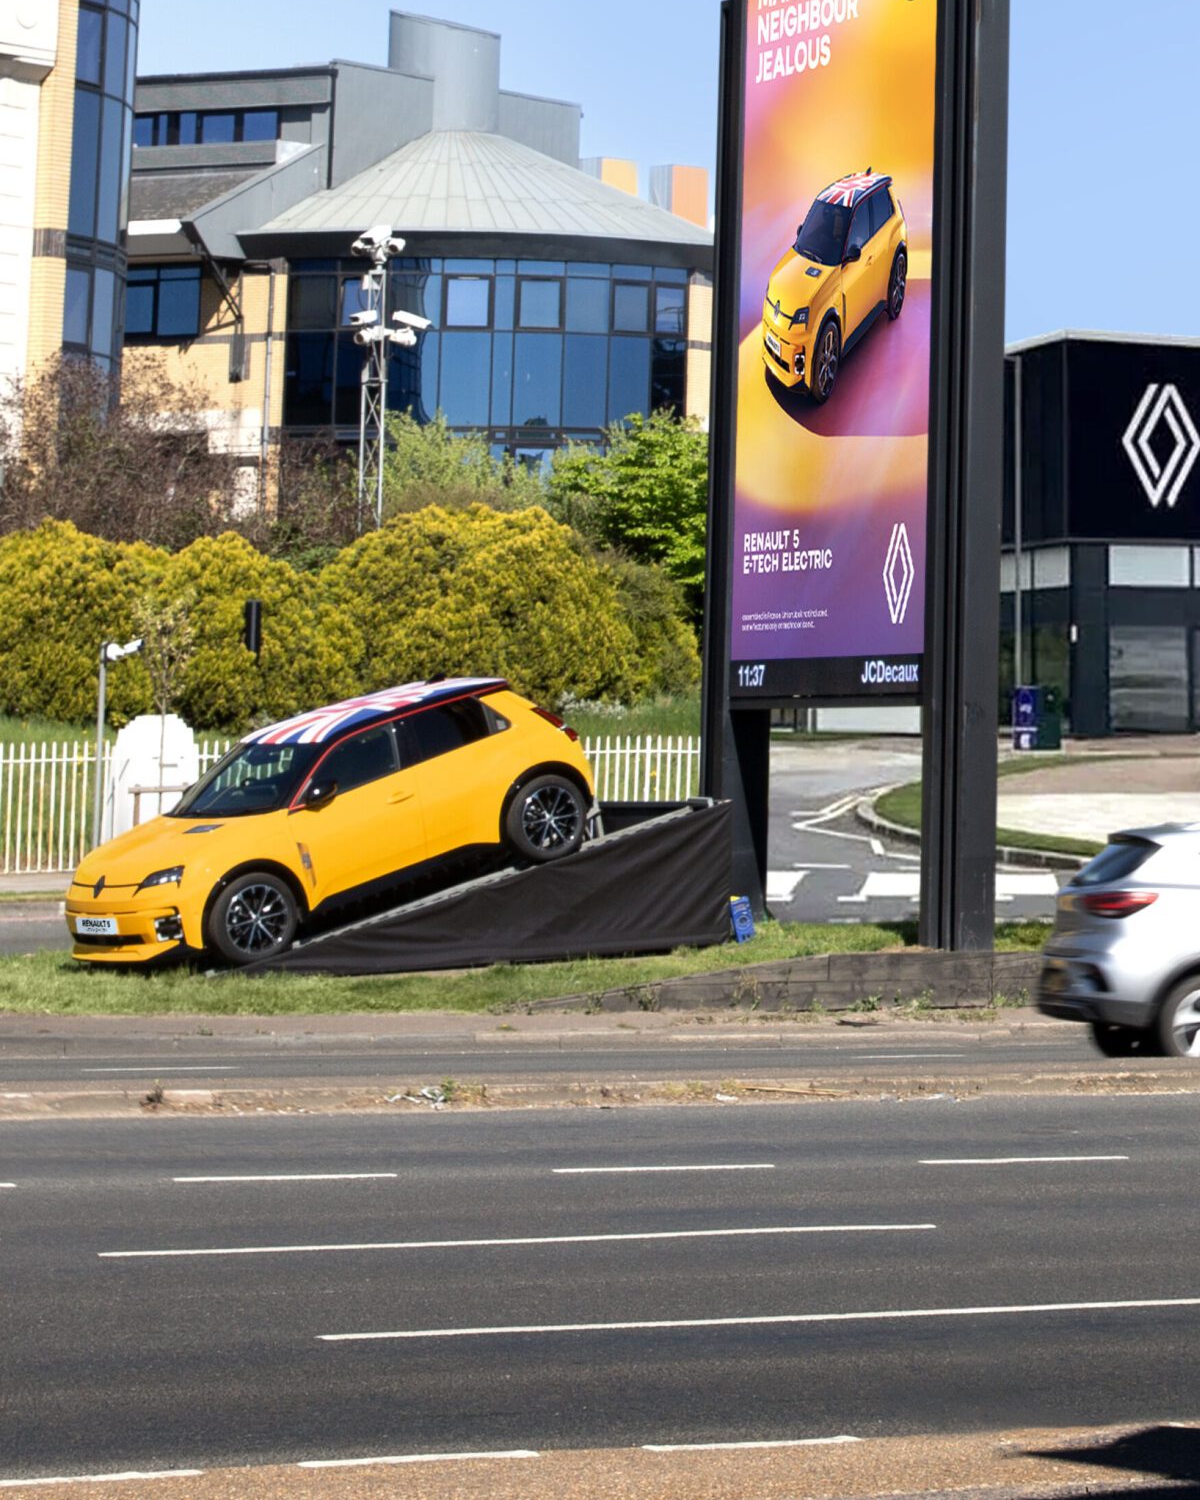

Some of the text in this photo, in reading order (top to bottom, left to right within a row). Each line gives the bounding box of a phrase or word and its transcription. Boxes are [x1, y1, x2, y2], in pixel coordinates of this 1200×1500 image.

[755, 33, 831, 83] JEALOUS
[744, 528, 800, 553] RENAULT 5
[743, 548, 833, 575] E-TECH ELECTRIC
[738, 664, 766, 687] 11:37
[861, 660, 919, 684] JCDecaux
